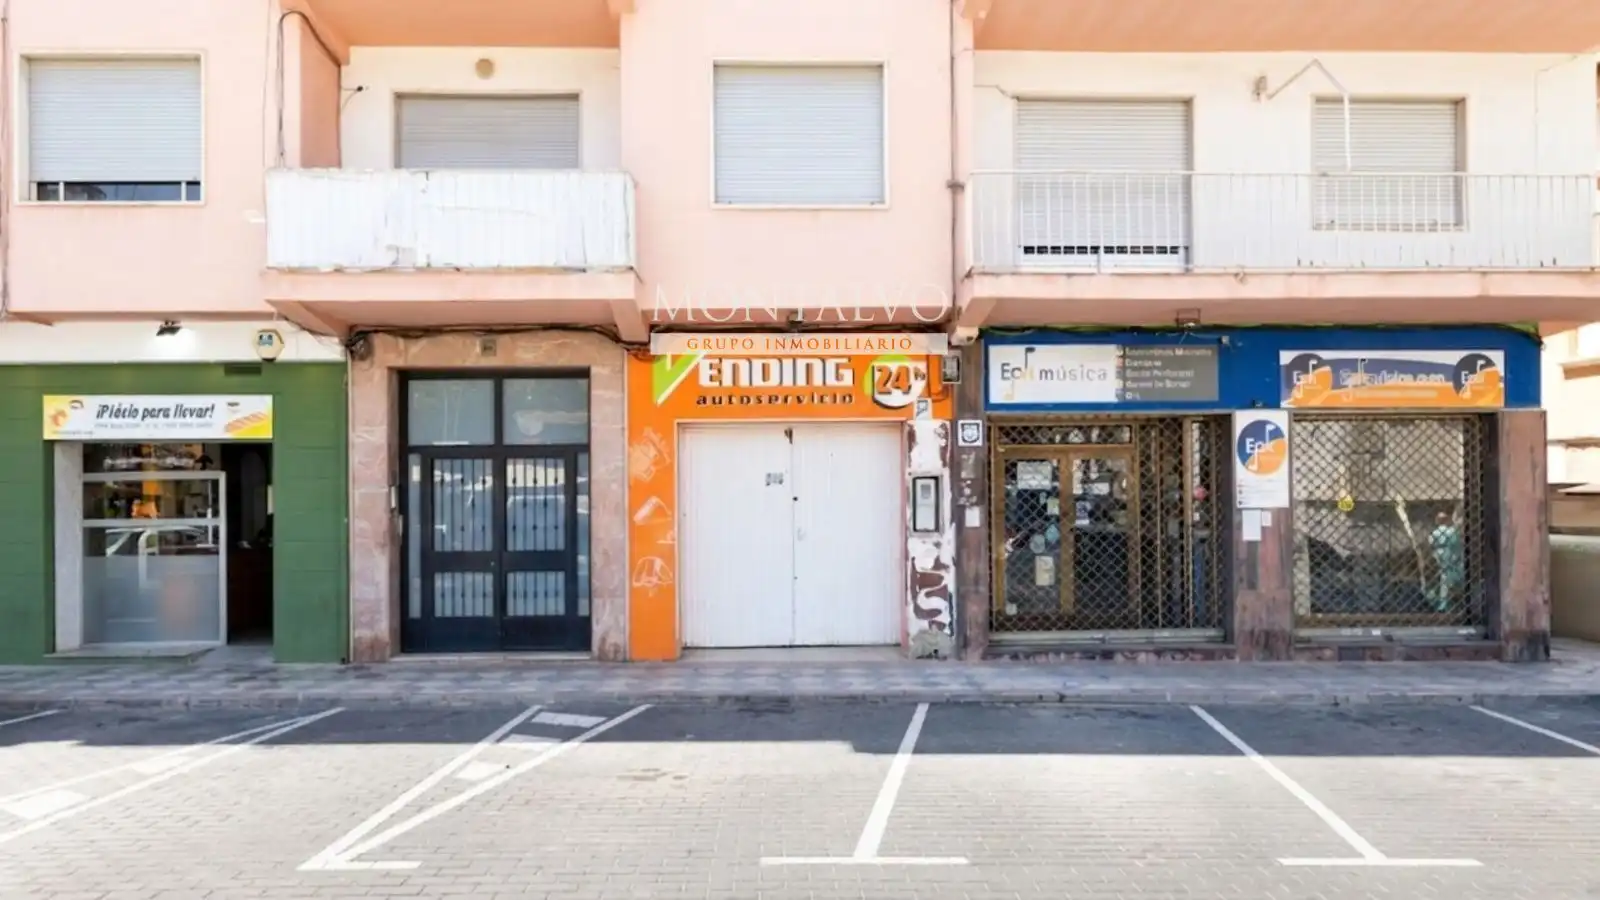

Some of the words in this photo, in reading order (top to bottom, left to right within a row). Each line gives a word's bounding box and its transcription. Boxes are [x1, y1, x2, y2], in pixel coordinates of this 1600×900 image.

[1039, 364, 1107, 381] música
[696, 392, 853, 406] autoservicio
[141, 407, 171, 421] para
